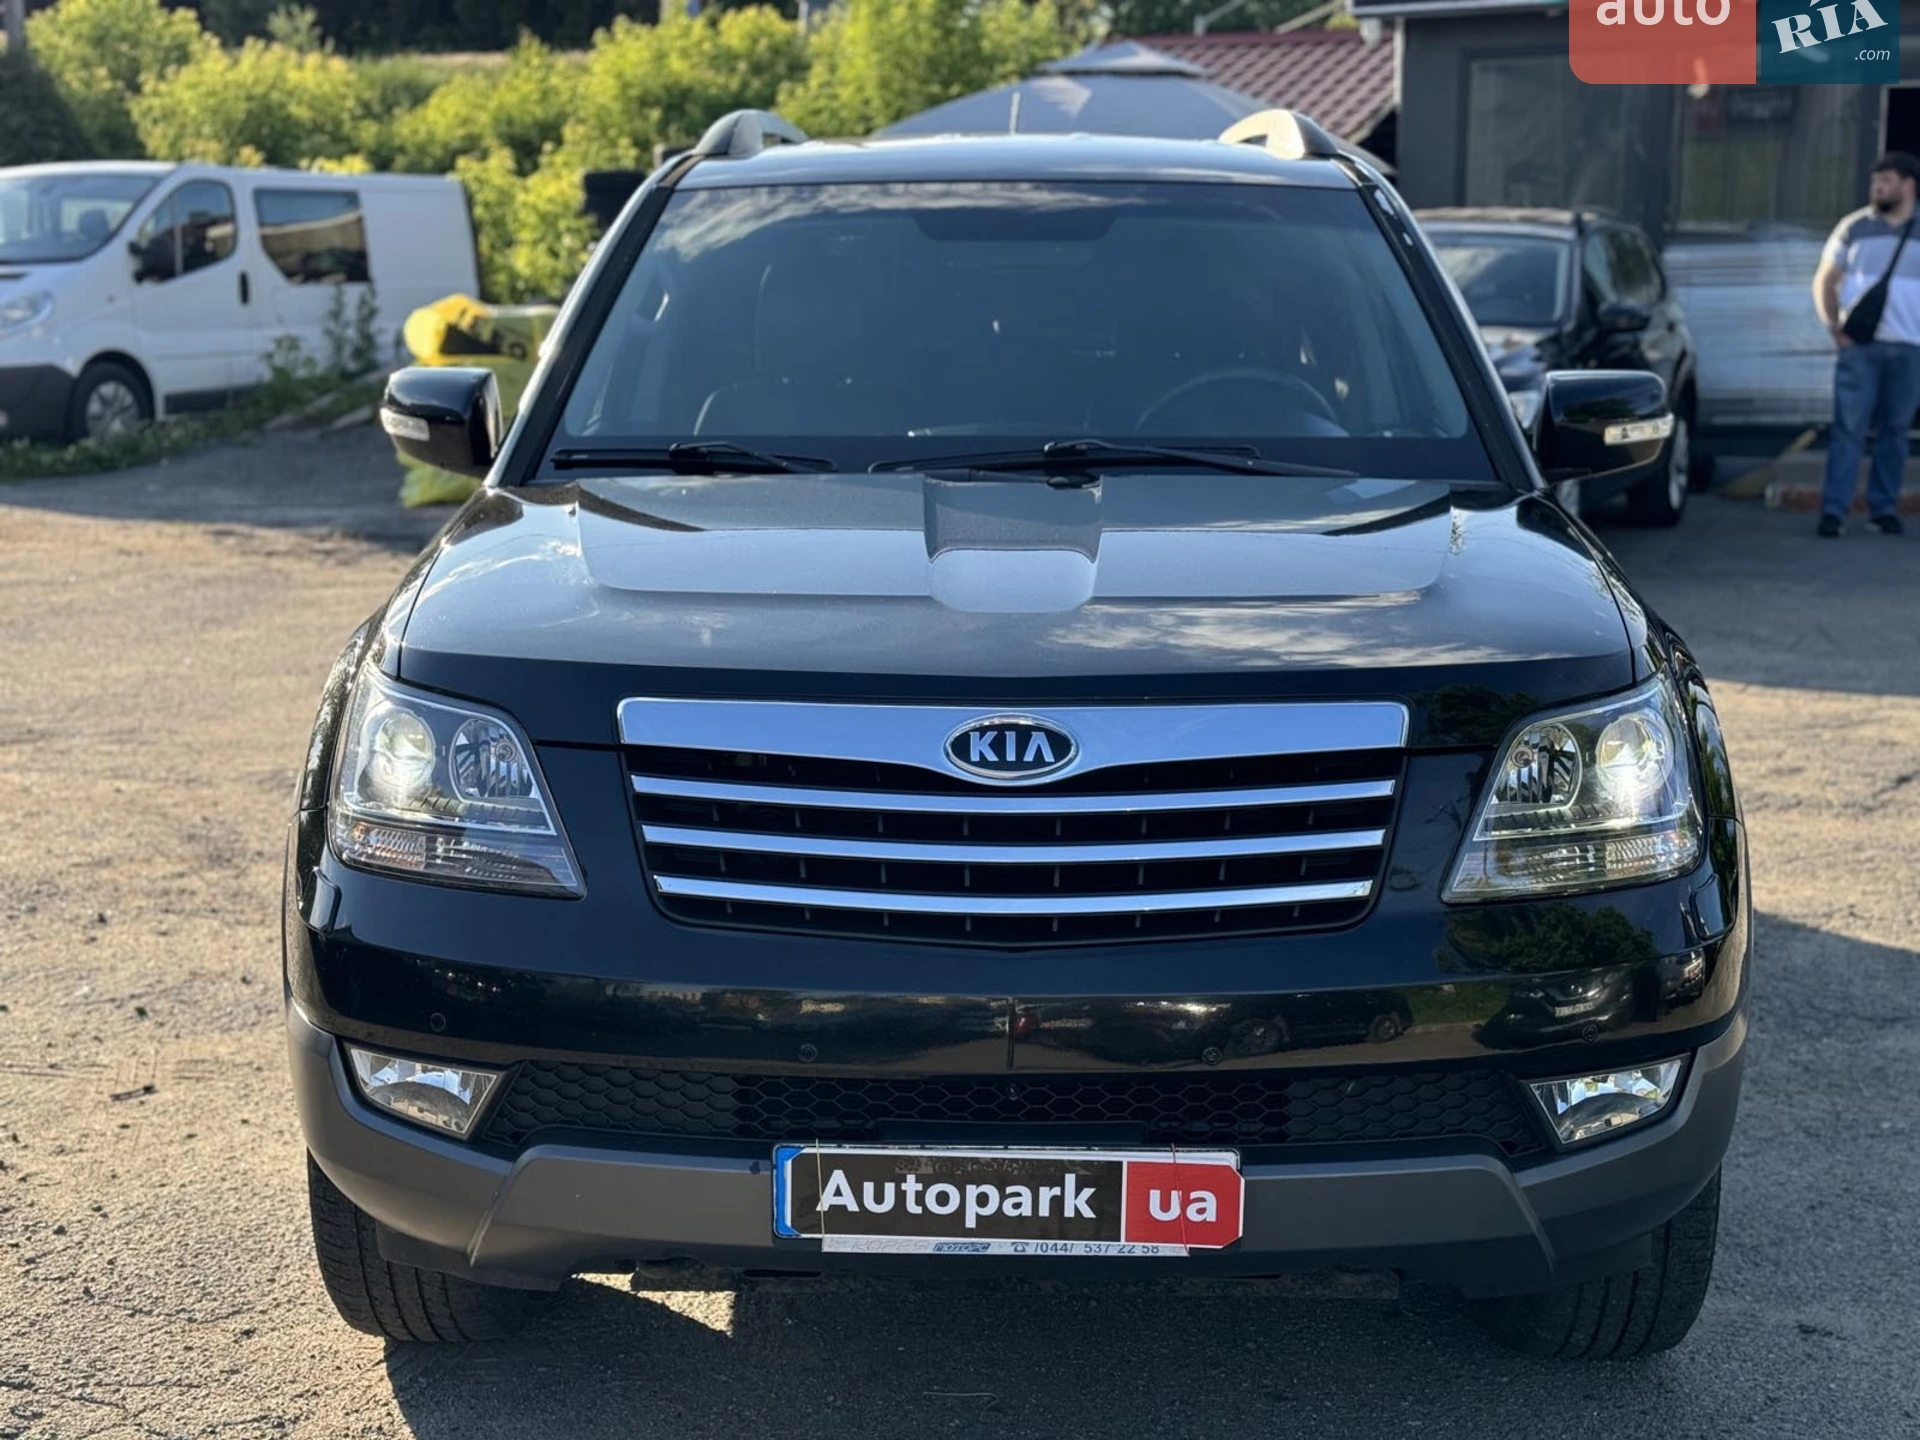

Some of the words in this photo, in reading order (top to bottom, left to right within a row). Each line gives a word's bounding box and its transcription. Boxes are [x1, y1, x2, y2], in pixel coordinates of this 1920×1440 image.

[968, 731, 1056, 762] KIA
[816, 1169, 1097, 1228] Autopark
[1149, 1189, 1218, 1222] ua
